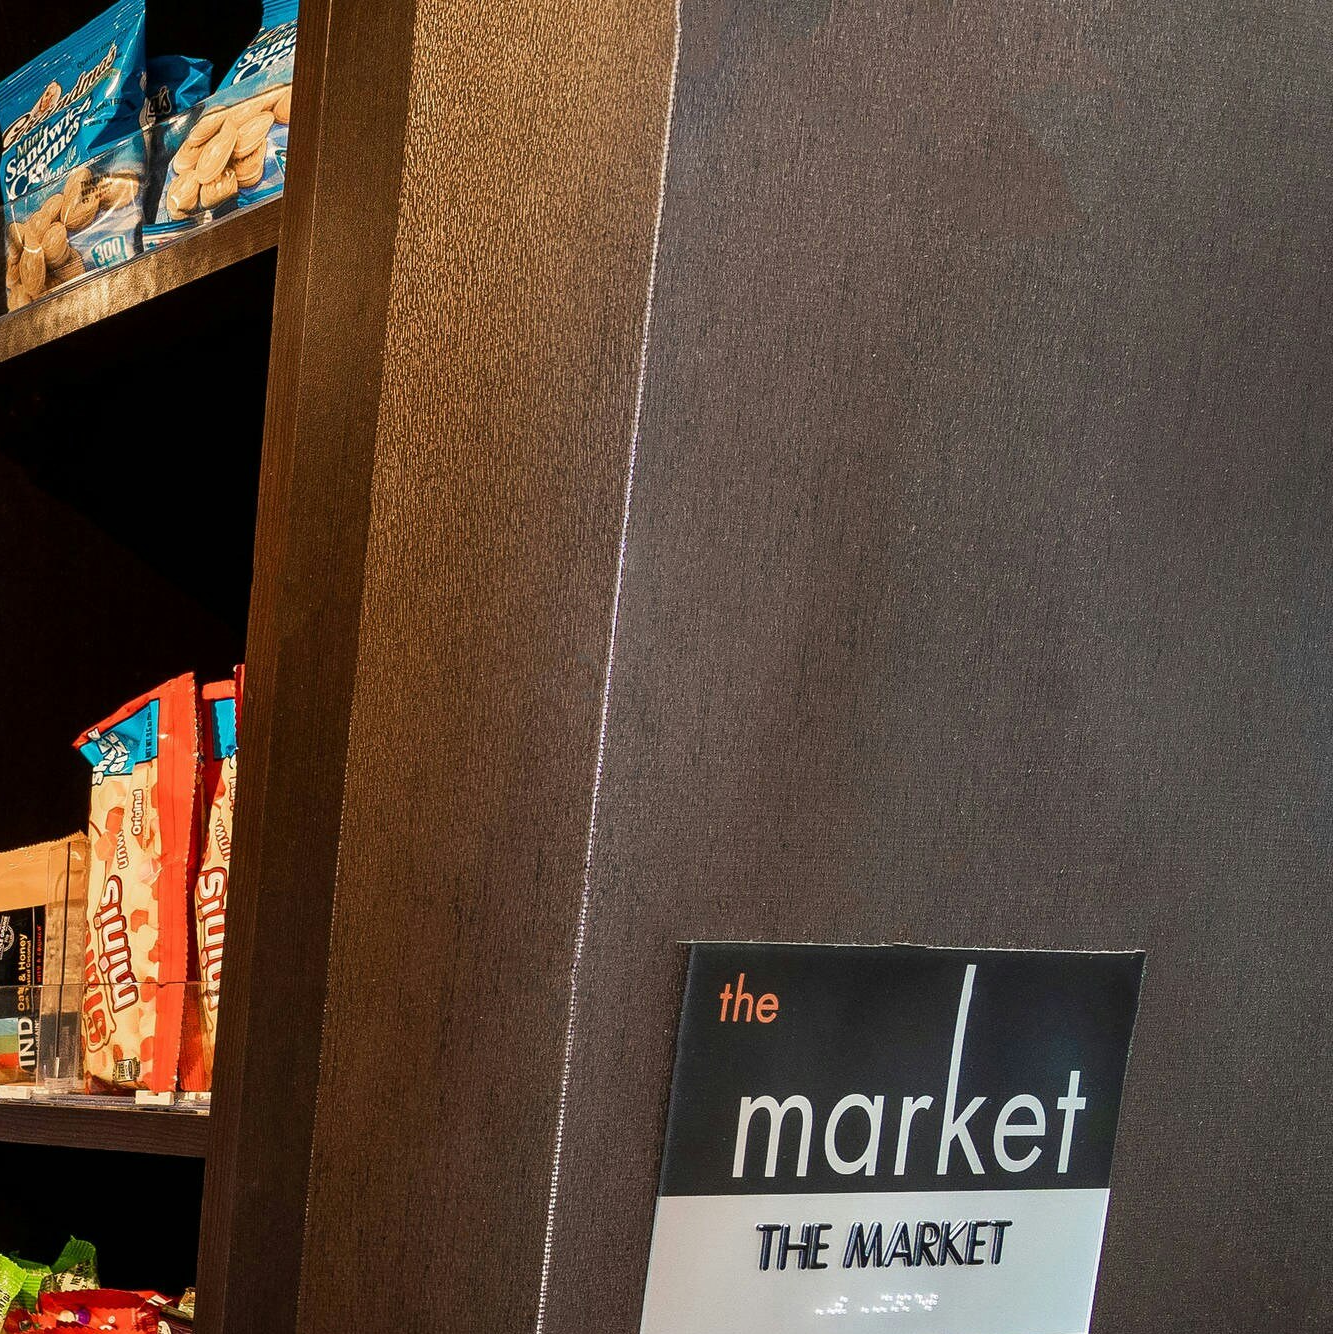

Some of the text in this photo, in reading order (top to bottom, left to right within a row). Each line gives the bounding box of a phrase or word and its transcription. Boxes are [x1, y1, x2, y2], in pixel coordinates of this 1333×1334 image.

[5, 96, 92, 183] Sandwich
[17, 126, 48, 159] Mini
[95, 241, 121, 264] 300
[131, 788, 144, 836] Original
[18, 933, 29, 967] Honey
[94, 875, 139, 1012] minis
[719, 972, 781, 1026] the
[732, 964, 1087, 1178] market
[755, 1217, 1014, 1272] THE MARKET
